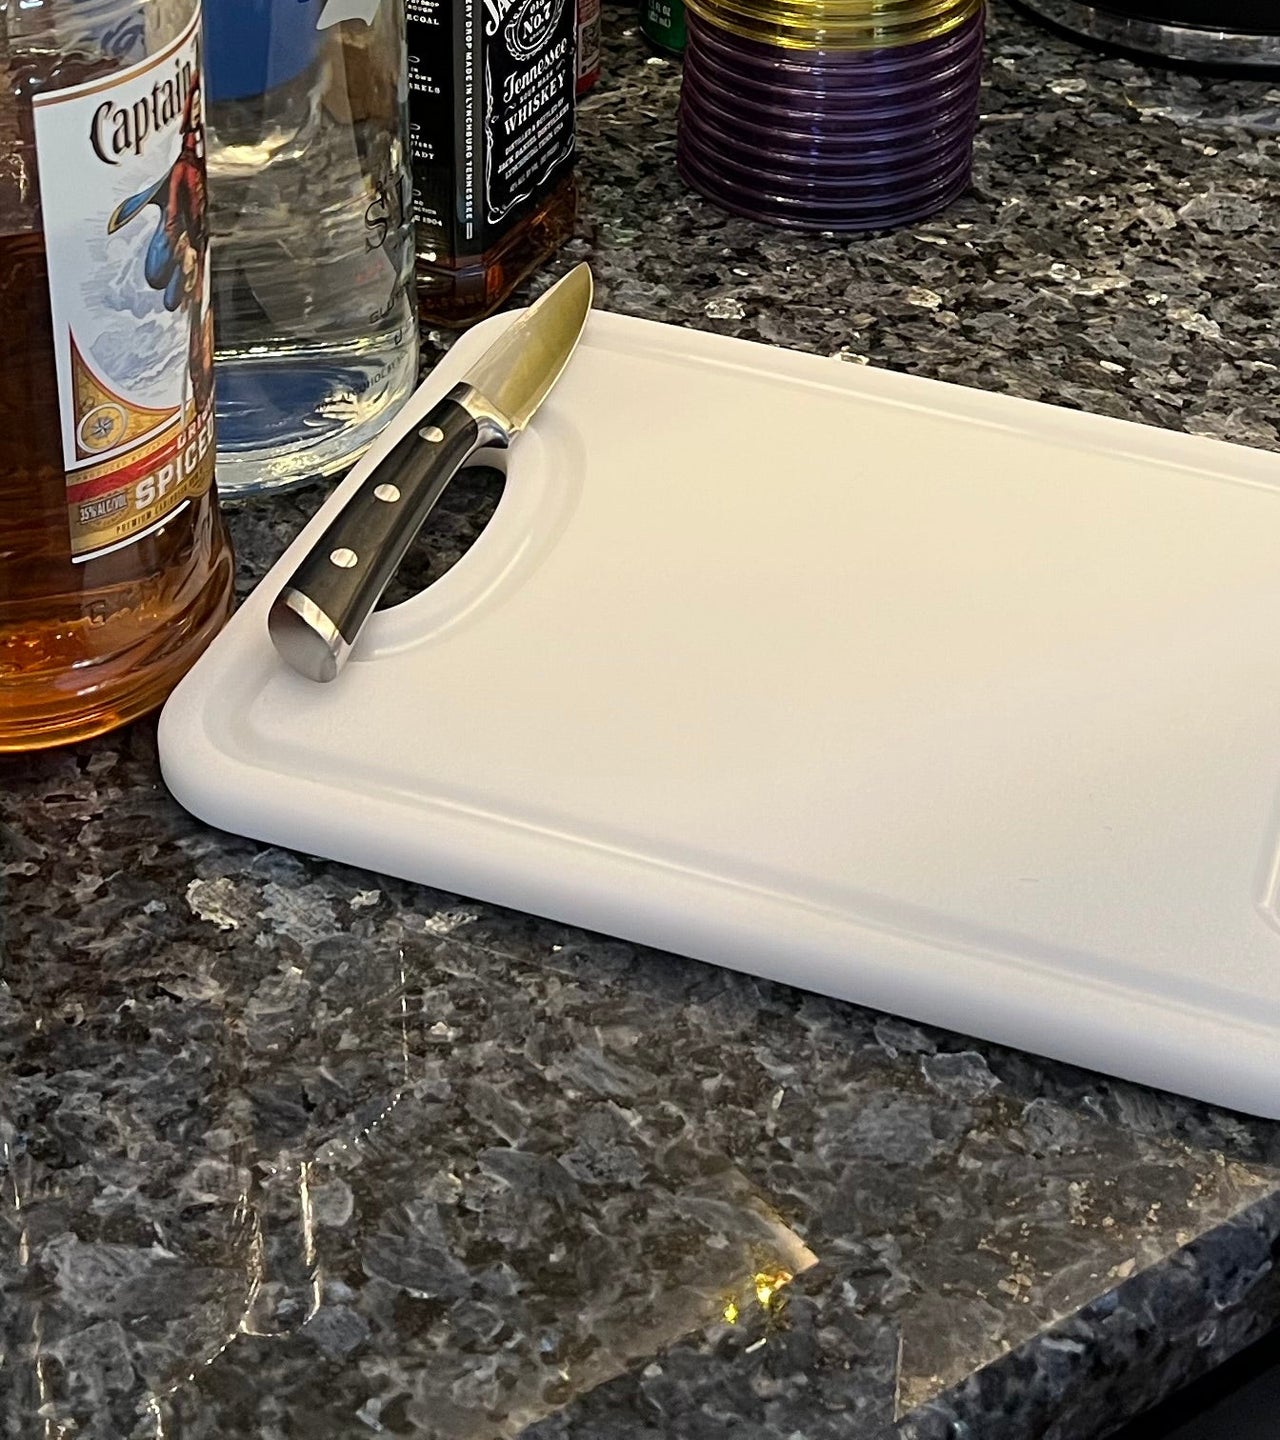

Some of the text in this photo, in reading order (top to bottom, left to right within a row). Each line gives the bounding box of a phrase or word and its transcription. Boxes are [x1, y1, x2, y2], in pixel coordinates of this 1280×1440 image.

[465, 21, 473, 50] DROP
[465, 51, 473, 81] MADE
[465, 82, 473, 95] IN
[503, 38, 567, 103] Tennessee
[89, 58, 192, 166] Captain
[465, 97, 473, 159] LYNCHBURG
[504, 69, 567, 135] WHISKEY
[465, 160, 473, 219] TENNESSEE
[135, 412, 215, 510] SPICED
